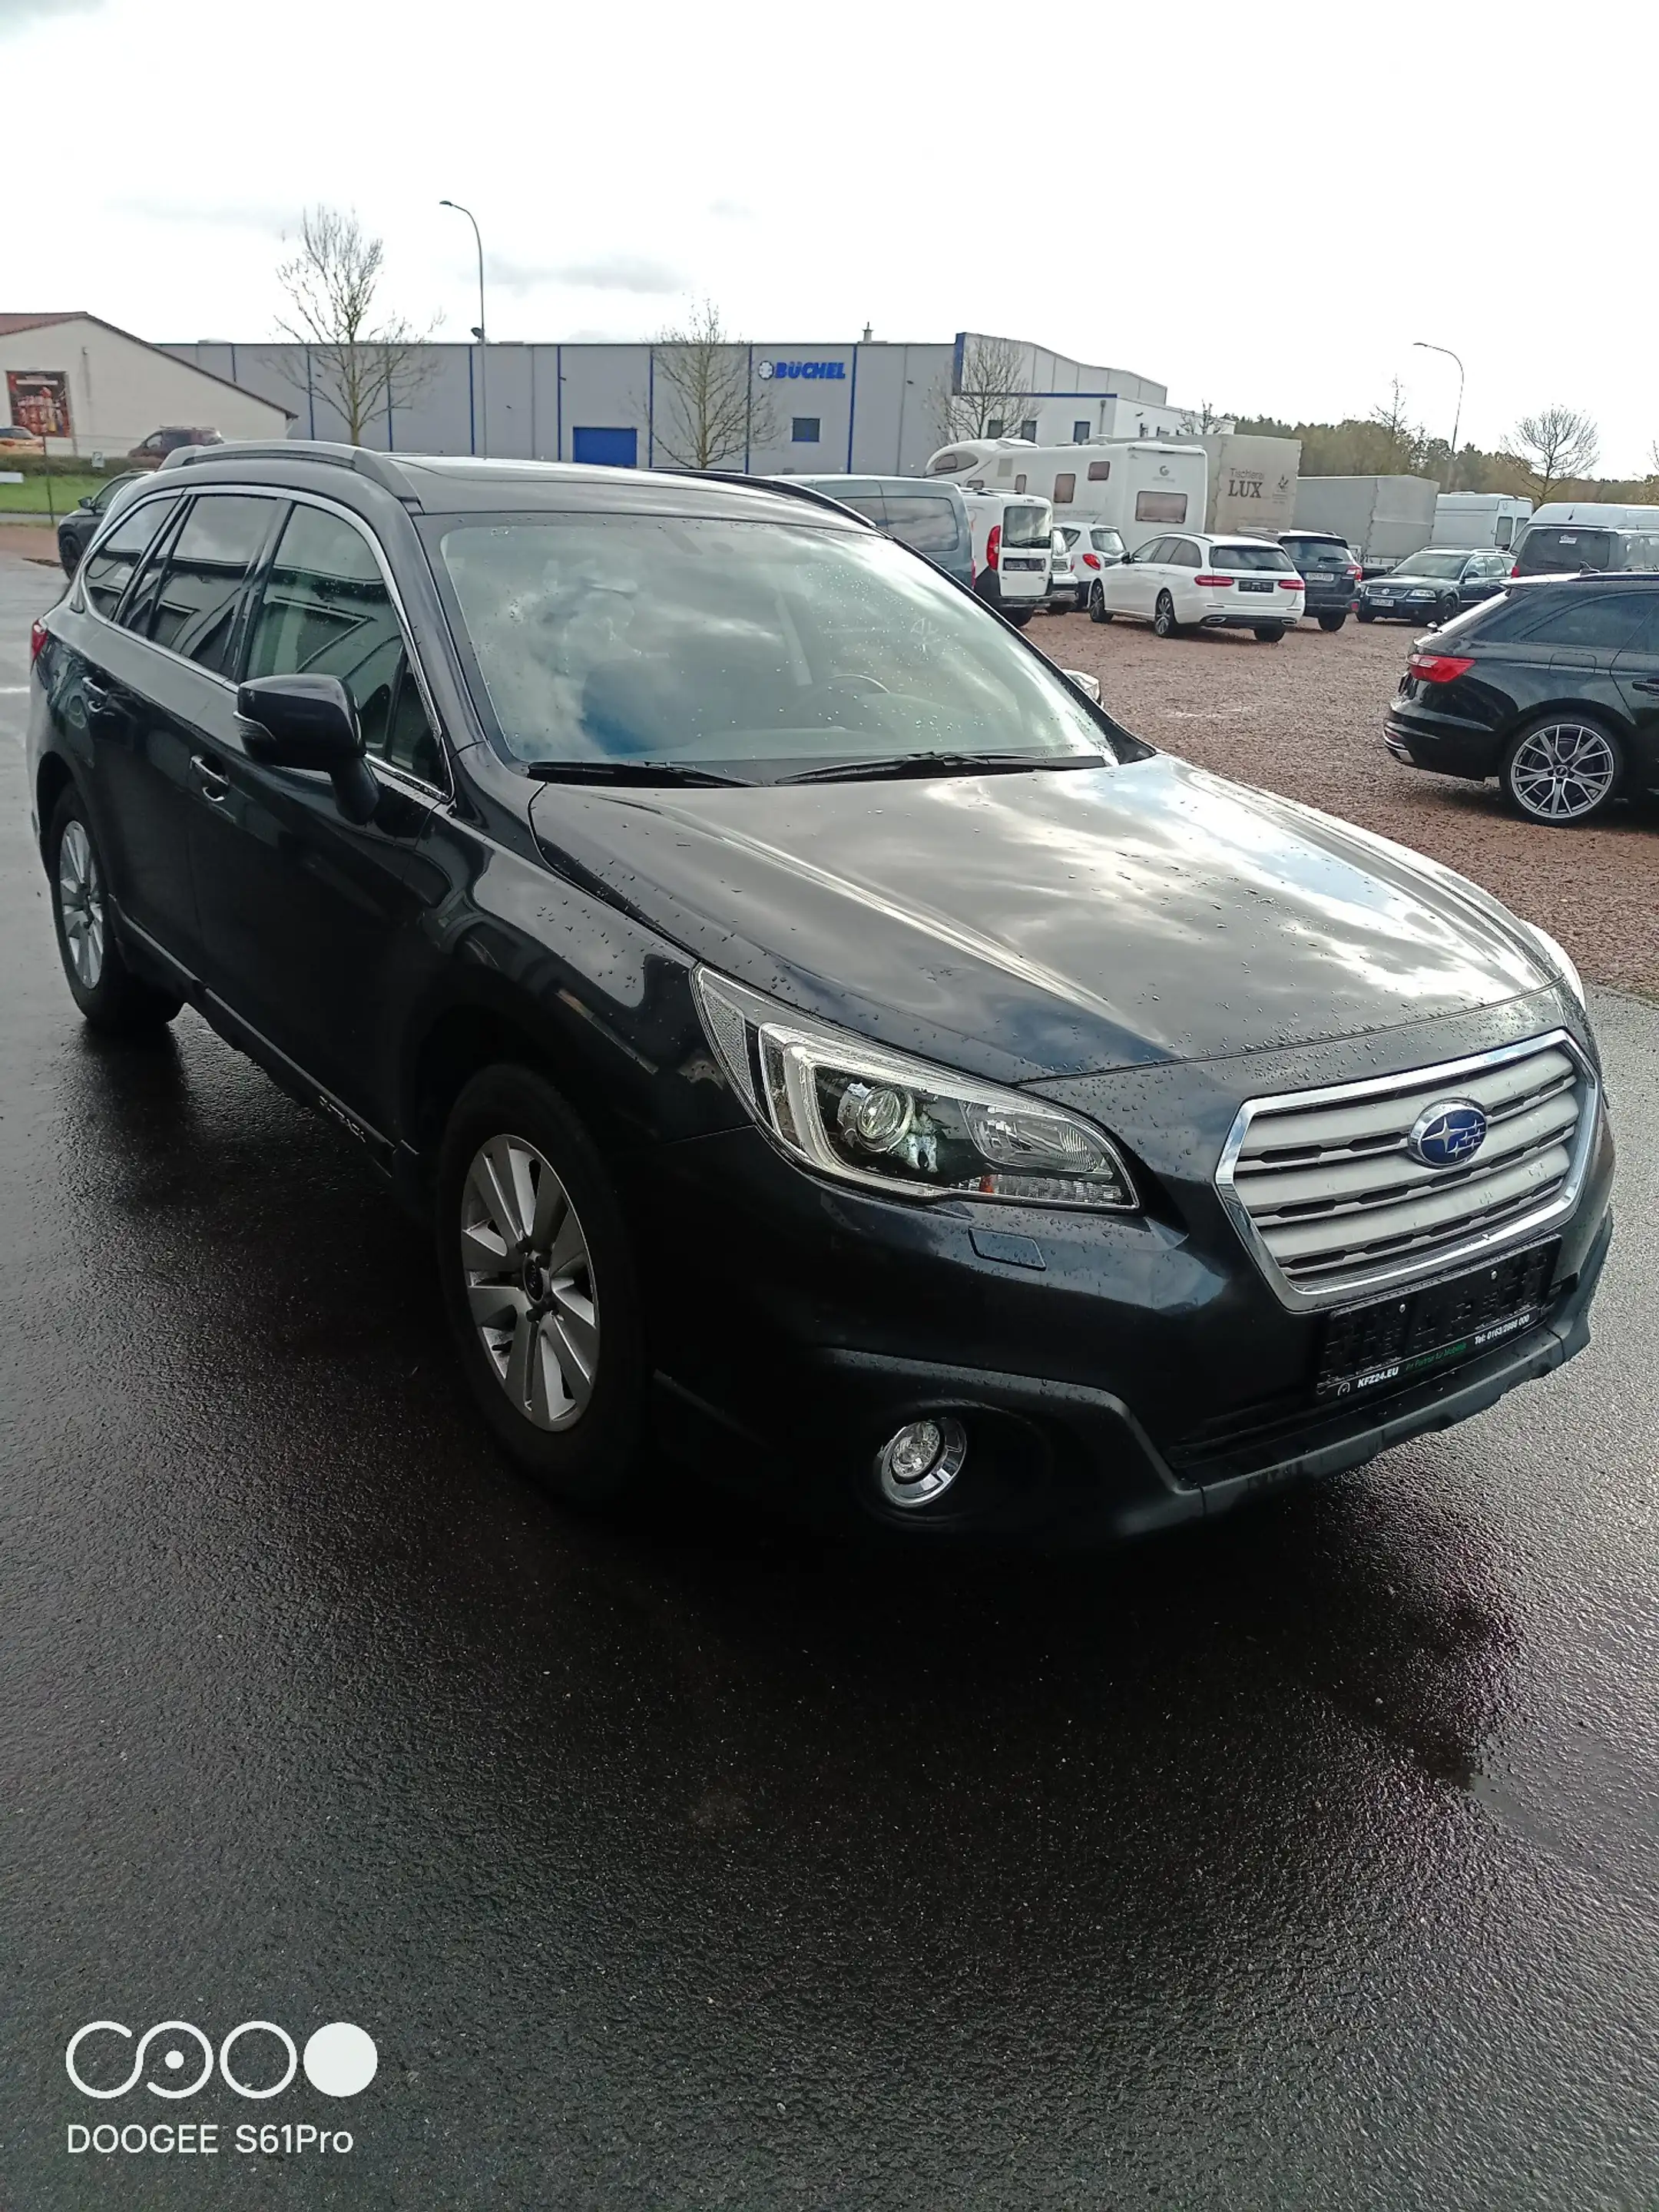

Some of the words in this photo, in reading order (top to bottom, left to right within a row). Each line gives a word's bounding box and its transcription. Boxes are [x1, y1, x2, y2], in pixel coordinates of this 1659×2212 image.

[775, 361, 846, 379] BÜCHEL
[1228, 479, 1263, 498] LUX
[1357, 1366, 1399, 1388] KFZ24.EU
